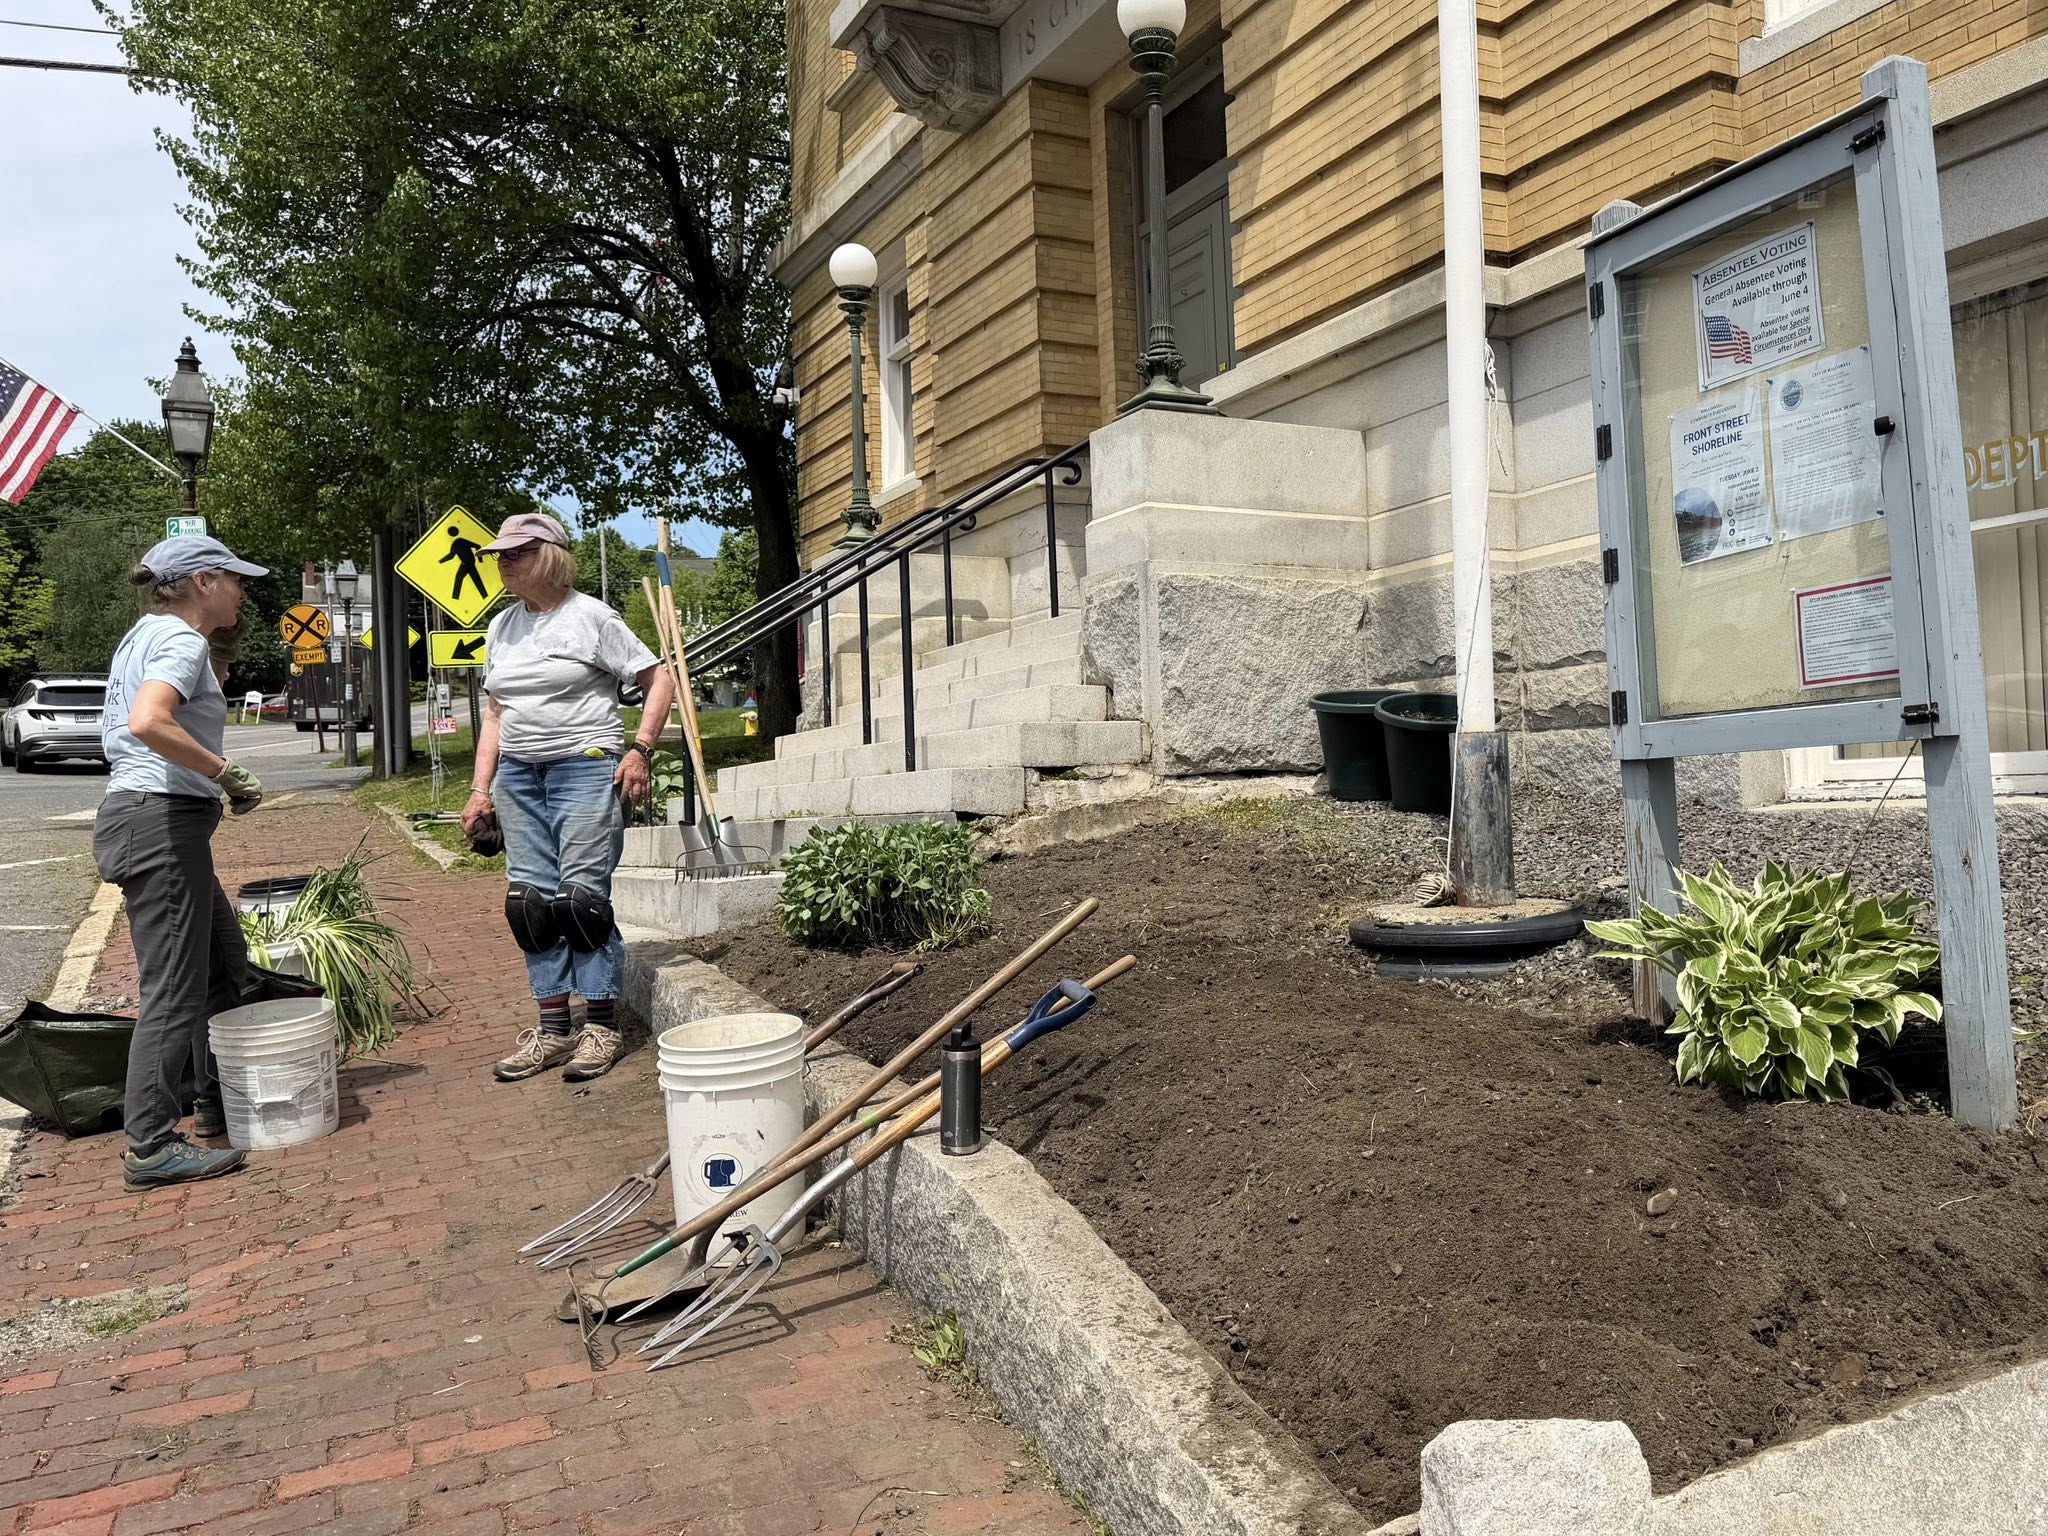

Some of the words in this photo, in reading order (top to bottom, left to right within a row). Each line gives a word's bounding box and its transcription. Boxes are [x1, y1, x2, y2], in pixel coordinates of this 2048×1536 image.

[1702, 255, 1757, 288] ABSENTEE
[1759, 234, 1807, 260] VOTING
[1704, 284, 1734, 306] General
[1735, 271, 1775, 293] Absentee
[1776, 257, 1807, 276] Voting
[1732, 286, 1770, 308] Available
[1772, 270, 1808, 292] through
[1781, 288, 1800, 305] June
[1802, 285, 1809, 296] 4
[1752, 327, 1778, 343] available
[1779, 323, 1789, 334] for
[1789, 314, 1811, 331] Special
[1760, 313, 1789, 329] Absentee
[1790, 304, 1810, 320] Voting
[1753, 332, 1797, 352] Circumstances
[1798, 325, 1812, 340] Only
[1777, 342, 1792, 354] after
[1806, 336, 1813, 344] 4
[1683, 425, 1712, 445] FRONT
[1715, 412, 1750, 433] STREET
[1691, 430, 1742, 457] SHORELINE
[170, 521, 178, 536] 2
[284, 623, 294, 633] R
[316, 619, 326, 630] R
[295, 652, 323, 662] EXEMPT
